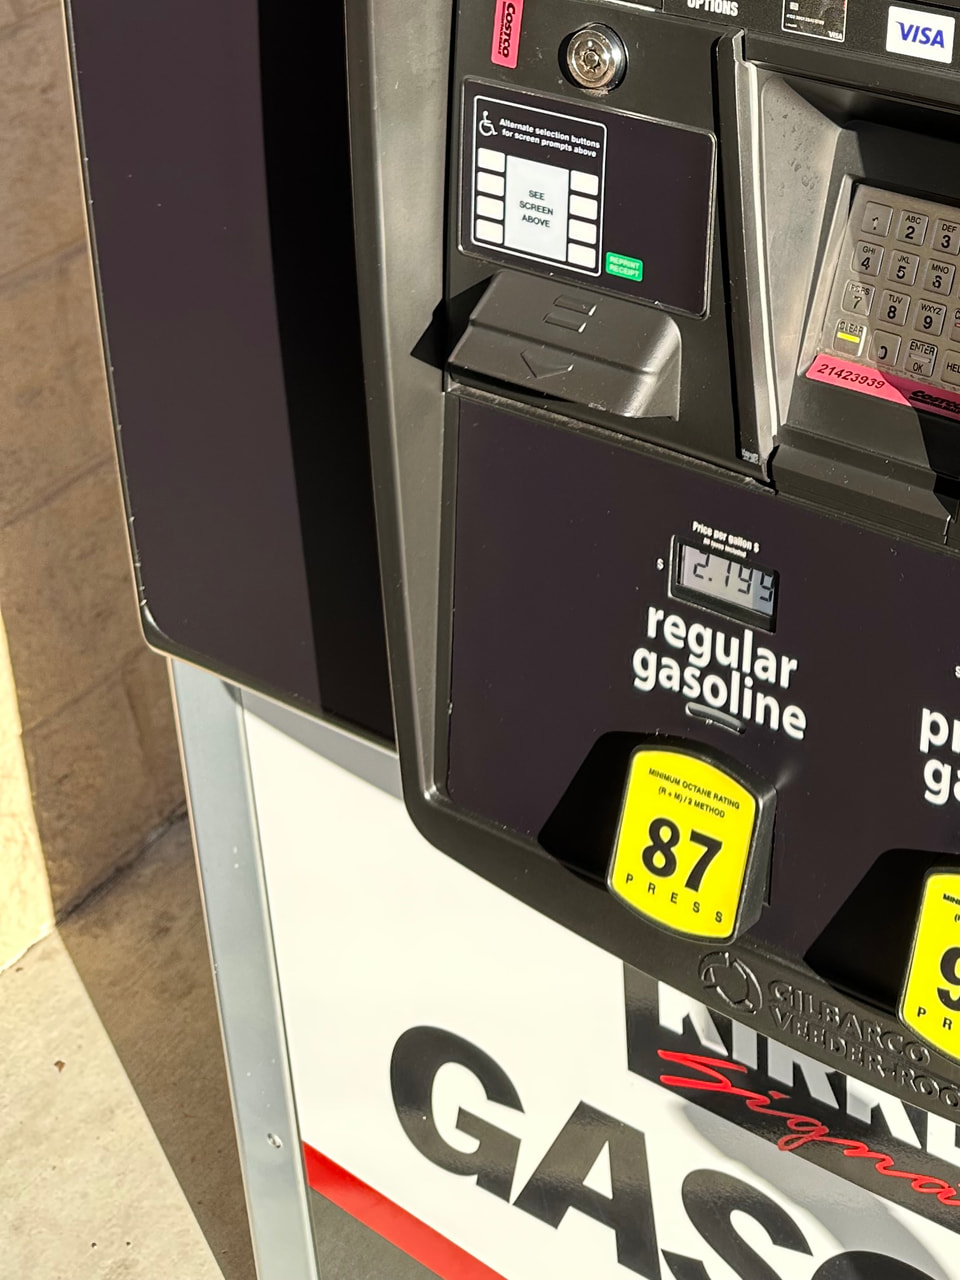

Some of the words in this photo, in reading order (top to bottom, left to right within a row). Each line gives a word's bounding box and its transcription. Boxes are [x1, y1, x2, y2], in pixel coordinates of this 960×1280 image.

[502, 2, 516, 59] COSTCO
[895, 21, 946, 49] VISA
[519, 200, 553, 215] SCREEN
[528, 189, 544, 200] SEE
[521, 214, 549, 227] ABOVE
[909, 341, 935, 356] ENTER
[816, 363, 886, 390] 21423939
[913, 362, 924, 373] OK
[647, 606, 797, 686] regular
[632, 647, 807, 740] gasoline
[641, 817, 722, 891] 87
[768, 978, 932, 1066] GILBARCO
